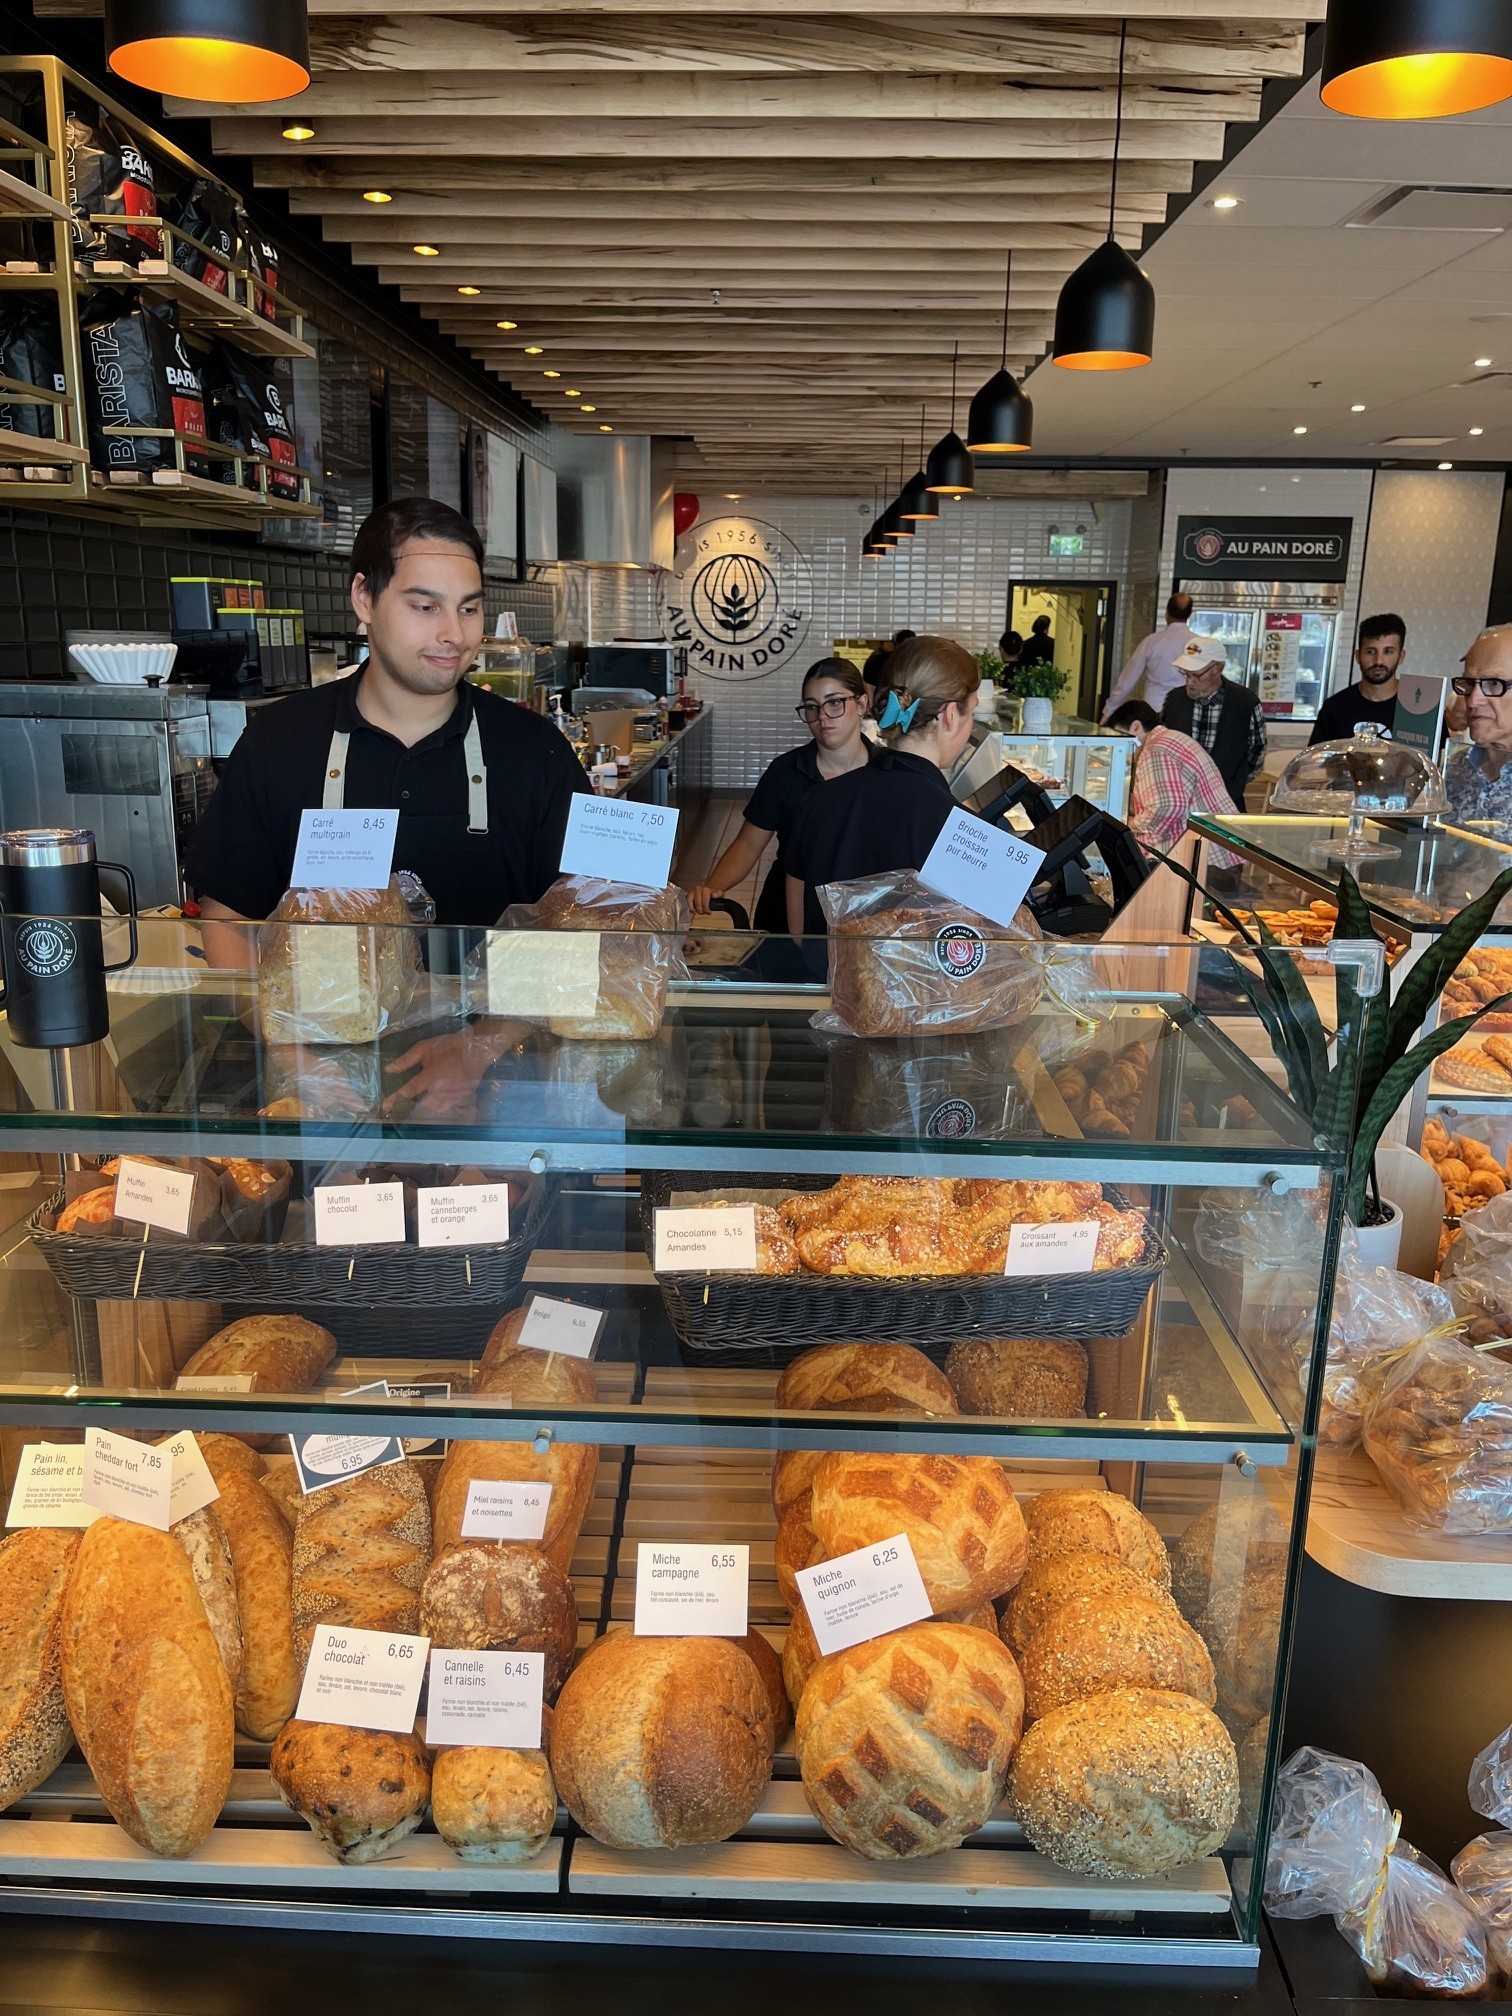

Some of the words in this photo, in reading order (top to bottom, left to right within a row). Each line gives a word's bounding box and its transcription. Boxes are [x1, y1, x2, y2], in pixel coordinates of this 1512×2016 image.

[90, 322, 137, 464] BARISTA
[717, 530, 757, 544] 1956
[1226, 542, 1249, 554] AU
[1252, 542, 1288, 555] PAIN
[1292, 540, 1334, 555] DORÉ
[667, 605, 692, 641] AU
[689, 639, 744, 671] PAIN
[751, 608, 802, 667] DORÉ
[584, 803, 608, 816] Carré
[610, 807, 634, 820] blanc
[641, 812, 664, 826] 7,50
[312, 817, 334, 828] Carré
[363, 818, 385, 829] 8,45
[310, 829, 351, 840] multigrain
[957, 821, 988, 843] Brioche
[952, 833, 989, 858] croissant
[946, 844, 961, 857] pur
[961, 850, 988, 871] beurre
[1005, 846, 1030, 865] 9,95
[18, 948, 28, 961] AU
[26, 961, 50, 974] PAIN
[52, 949, 73, 971] DORÉ
[944, 962, 954, 972] AU
[954, 965, 972, 975] PAIN
[127, 1177, 146, 1188] Muffin
[125, 1190, 153, 1203] Amandes
[327, 1196, 351, 1204] Muffin
[377, 1193, 394, 1202] 3,65
[430, 1197, 455, 1206] Muffin
[482, 1194, 499, 1204] 3,65
[327, 1204, 358, 1214] chocolat
[431, 1205, 477, 1215] canneberges
[440, 1215, 466, 1224] orange
[667, 1228, 717, 1239] Chocolatine
[724, 1228, 743, 1237] 5,15
[1021, 1232, 1056, 1240] Croissant
[667, 1243, 707, 1252] Amandes
[1035, 1240, 1068, 1248] amandes
[389, 1389, 421, 1397] Origine
[96, 1437, 112, 1451] Pain
[34, 1454, 53, 1464] Pain
[55, 1453, 68, 1465] lin,
[95, 1450, 124, 1467] cheddar
[125, 1460, 139, 1473] fort
[141, 1453, 162, 1469] 7,85
[341, 1454, 363, 1470] 6,95
[31, 1465, 64, 1476] sésame
[66, 1467, 76, 1476] et
[473, 1496, 489, 1504] Miel
[490, 1497, 513, 1505] raisins
[523, 1499, 540, 1507] 8,45
[480, 1509, 513, 1517] noisettes
[652, 1554, 681, 1565] Miche
[711, 1555, 736, 1569] 6,55
[872, 1548, 899, 1567] 6,25
[652, 1569, 700, 1581] campagne
[812, 1570, 843, 1587] Miche
[817, 1579, 857, 1600] quignon
[327, 1636, 347, 1649] Duo
[388, 1643, 414, 1659] 6,65
[324, 1649, 366, 1666] chocolat
[444, 1660, 484, 1673] Cannelle
[504, 1662, 530, 1677] 6,45
[444, 1676, 453, 1685] et
[455, 1675, 486, 1686] raisins
